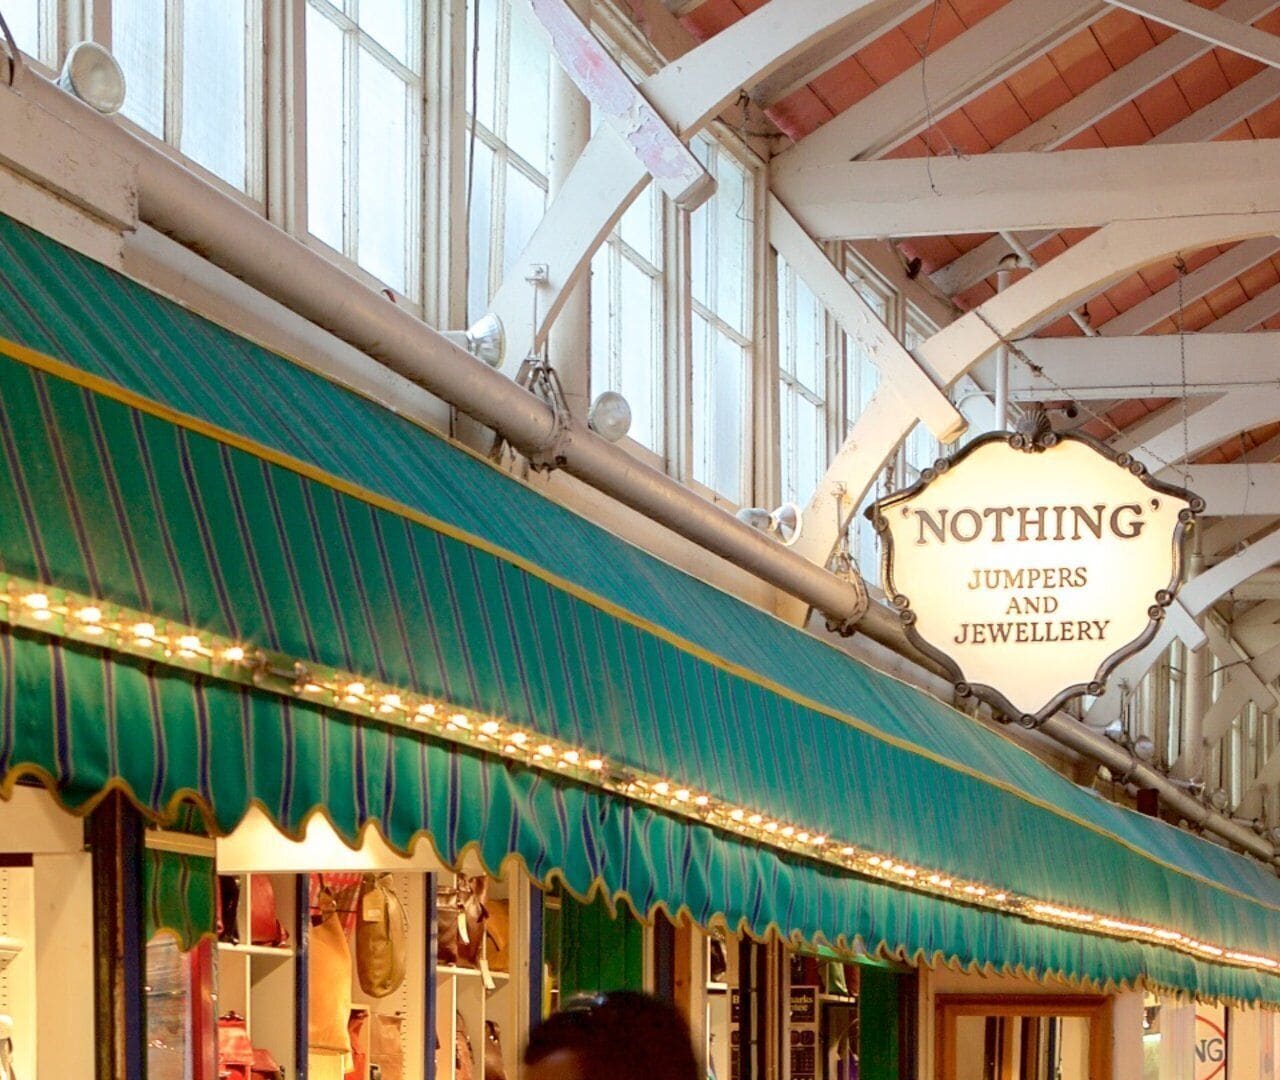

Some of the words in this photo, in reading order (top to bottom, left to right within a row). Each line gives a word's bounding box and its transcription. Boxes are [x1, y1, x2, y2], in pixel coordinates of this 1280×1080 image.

[968, 567, 1088, 590] JUMPERS
[1005, 596, 1058, 615] AND
[954, 620, 1110, 645] JEWELLERY
